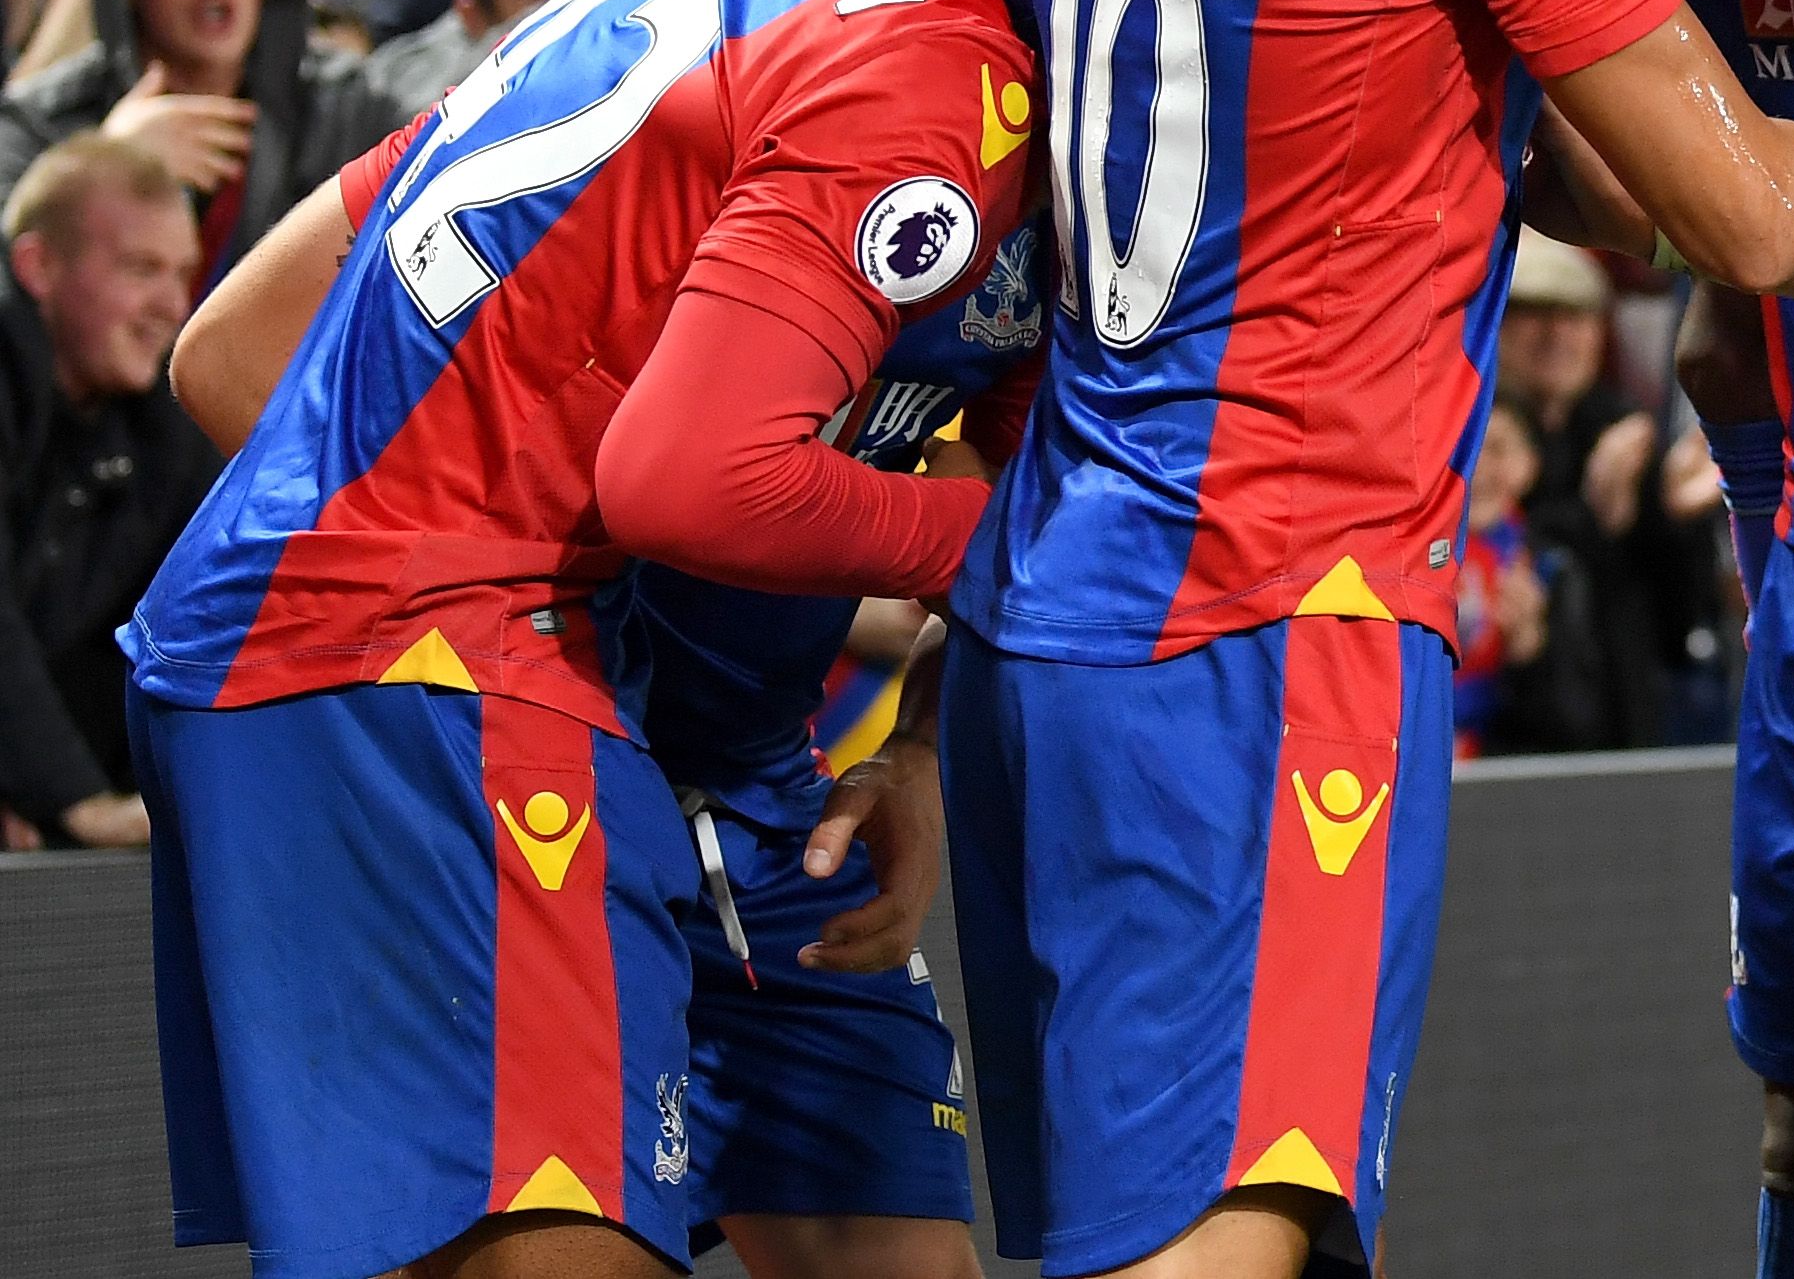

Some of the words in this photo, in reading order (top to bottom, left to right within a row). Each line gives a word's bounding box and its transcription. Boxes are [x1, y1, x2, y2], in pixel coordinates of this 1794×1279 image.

[868, 203, 896, 243] Premier
[867, 245, 884, 285] League
[856, 380, 955, 468] 明
